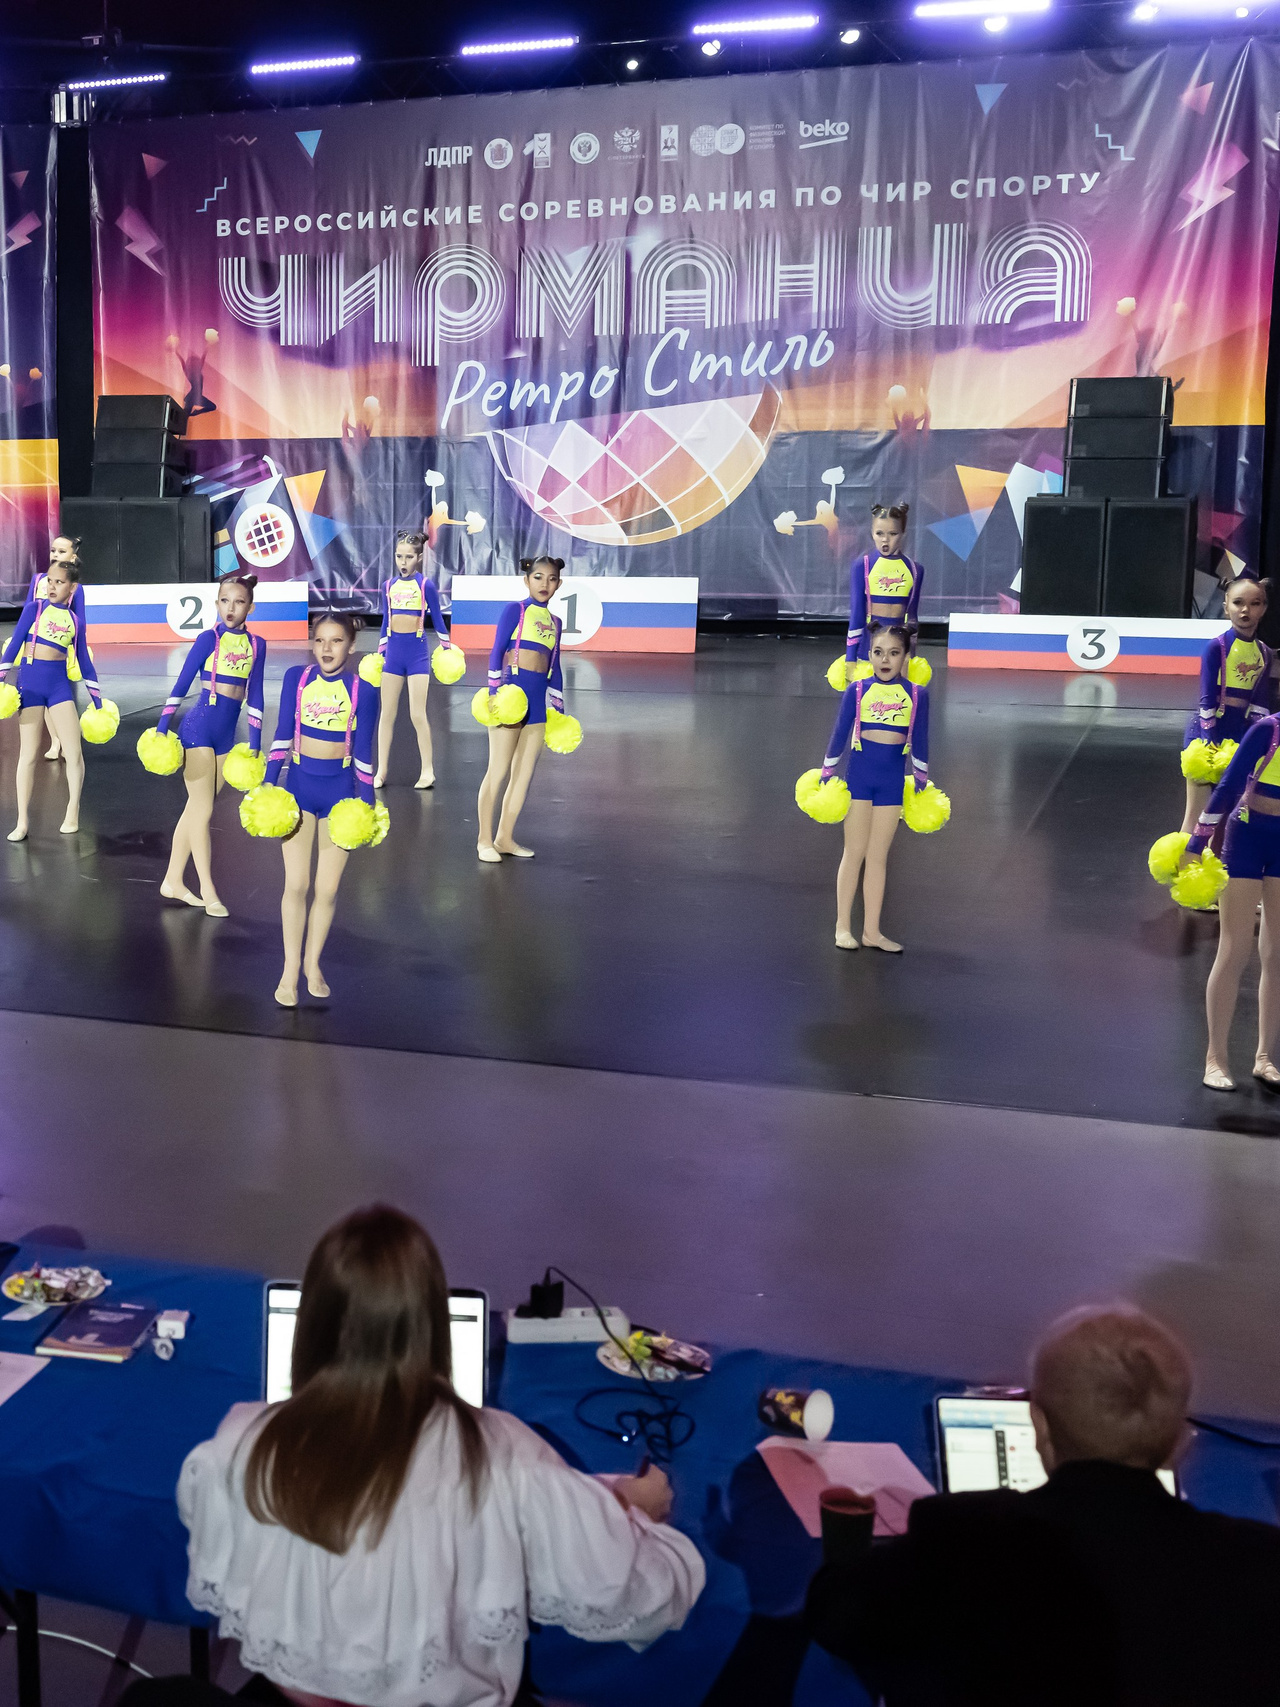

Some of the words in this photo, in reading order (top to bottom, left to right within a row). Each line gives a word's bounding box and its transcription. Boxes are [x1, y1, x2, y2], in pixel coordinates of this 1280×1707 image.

[799, 119, 850, 137] beko
[424, 146, 473, 168] ЛДПР
[216, 206, 483, 237] ВСЕРОССИЙСКИЕ
[498, 189, 776, 223] СОРЕВНОВАНИЯ
[795, 185, 842, 207] ПО
[860, 181, 932, 203] ЧИР
[950, 172, 1100, 199] СПОРТУ
[440, 360, 619, 430] Ретро
[643, 326, 836, 397] Стиль
[179, 596, 204, 630] 2
[560, 593, 582, 634] 1
[1080, 628, 1107, 661] 3
